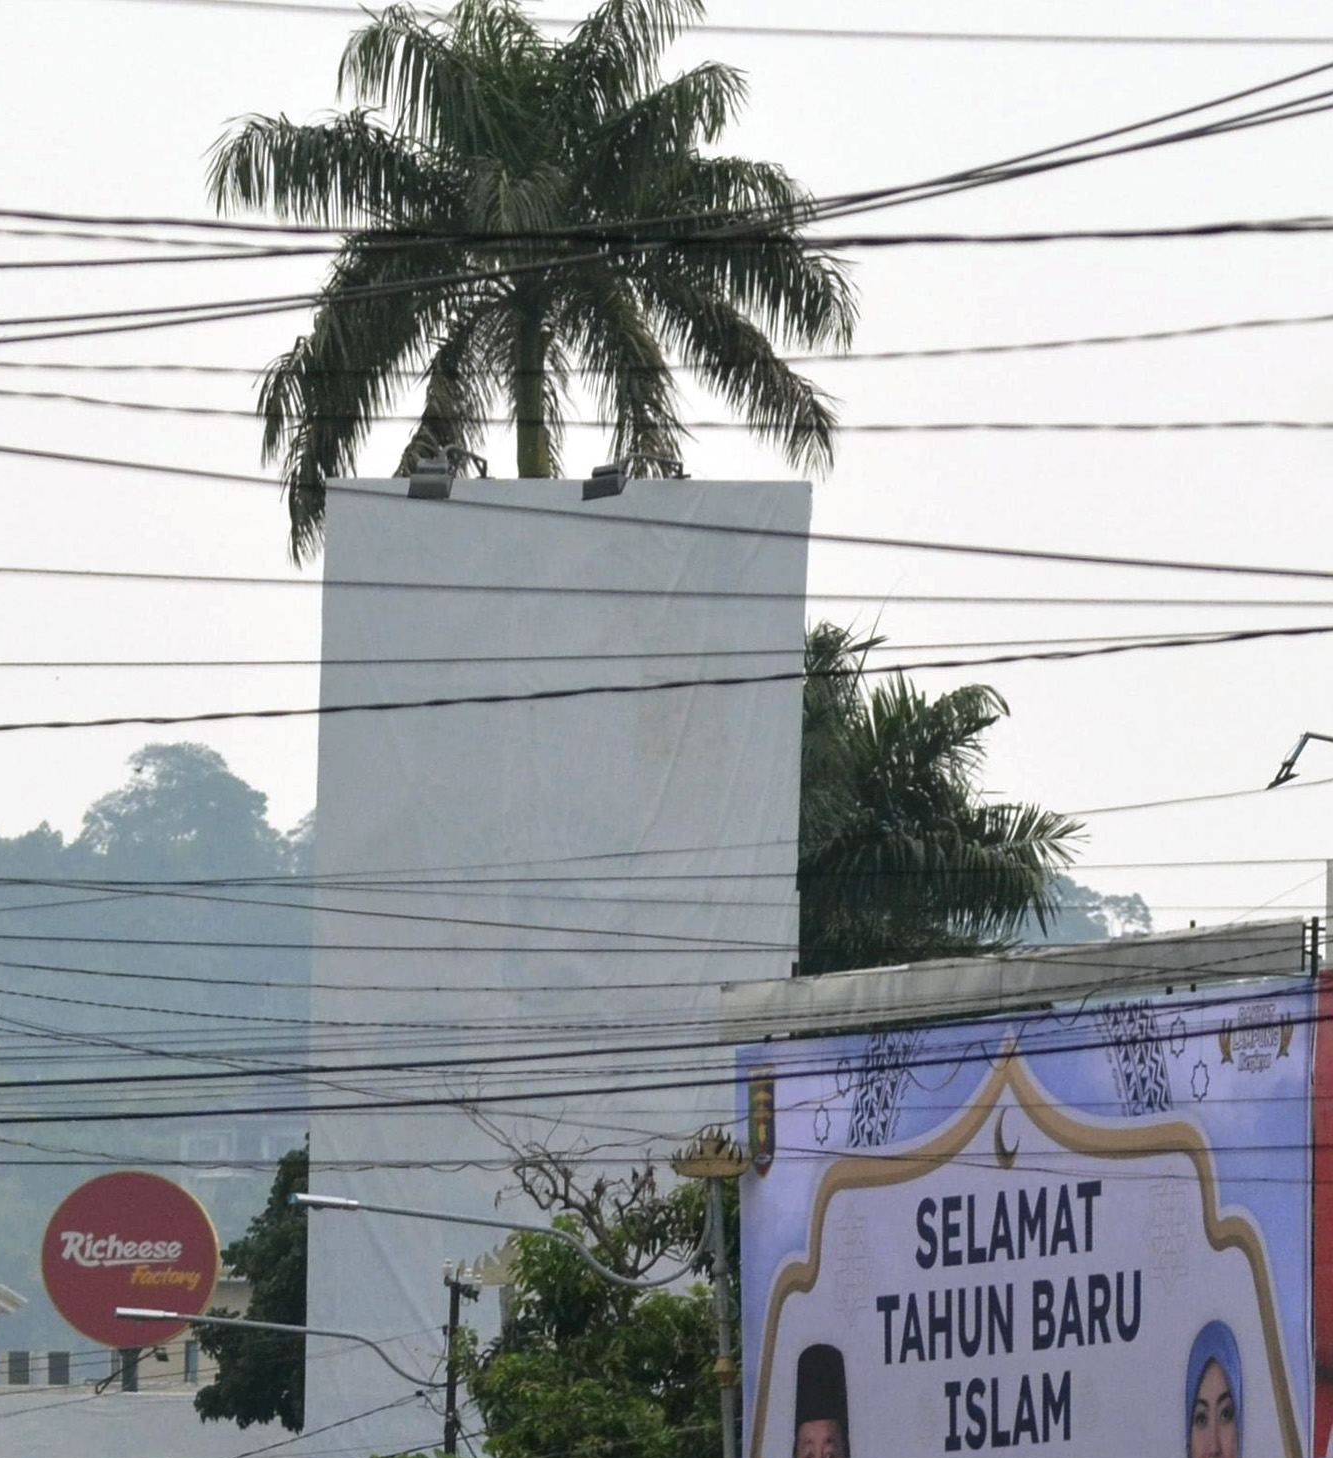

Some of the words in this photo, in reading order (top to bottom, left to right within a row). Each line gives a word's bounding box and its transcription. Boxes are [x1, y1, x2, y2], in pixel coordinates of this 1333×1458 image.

[60, 1231, 183, 1267] Richeese
[915, 1181, 1101, 1270] SELAMAT
[130, 1264, 203, 1292] Factory
[876, 1283, 1015, 1366] TAHUN
[1031, 1270, 1142, 1351] BARU
[944, 1371, 1072, 1452] ISLAM
